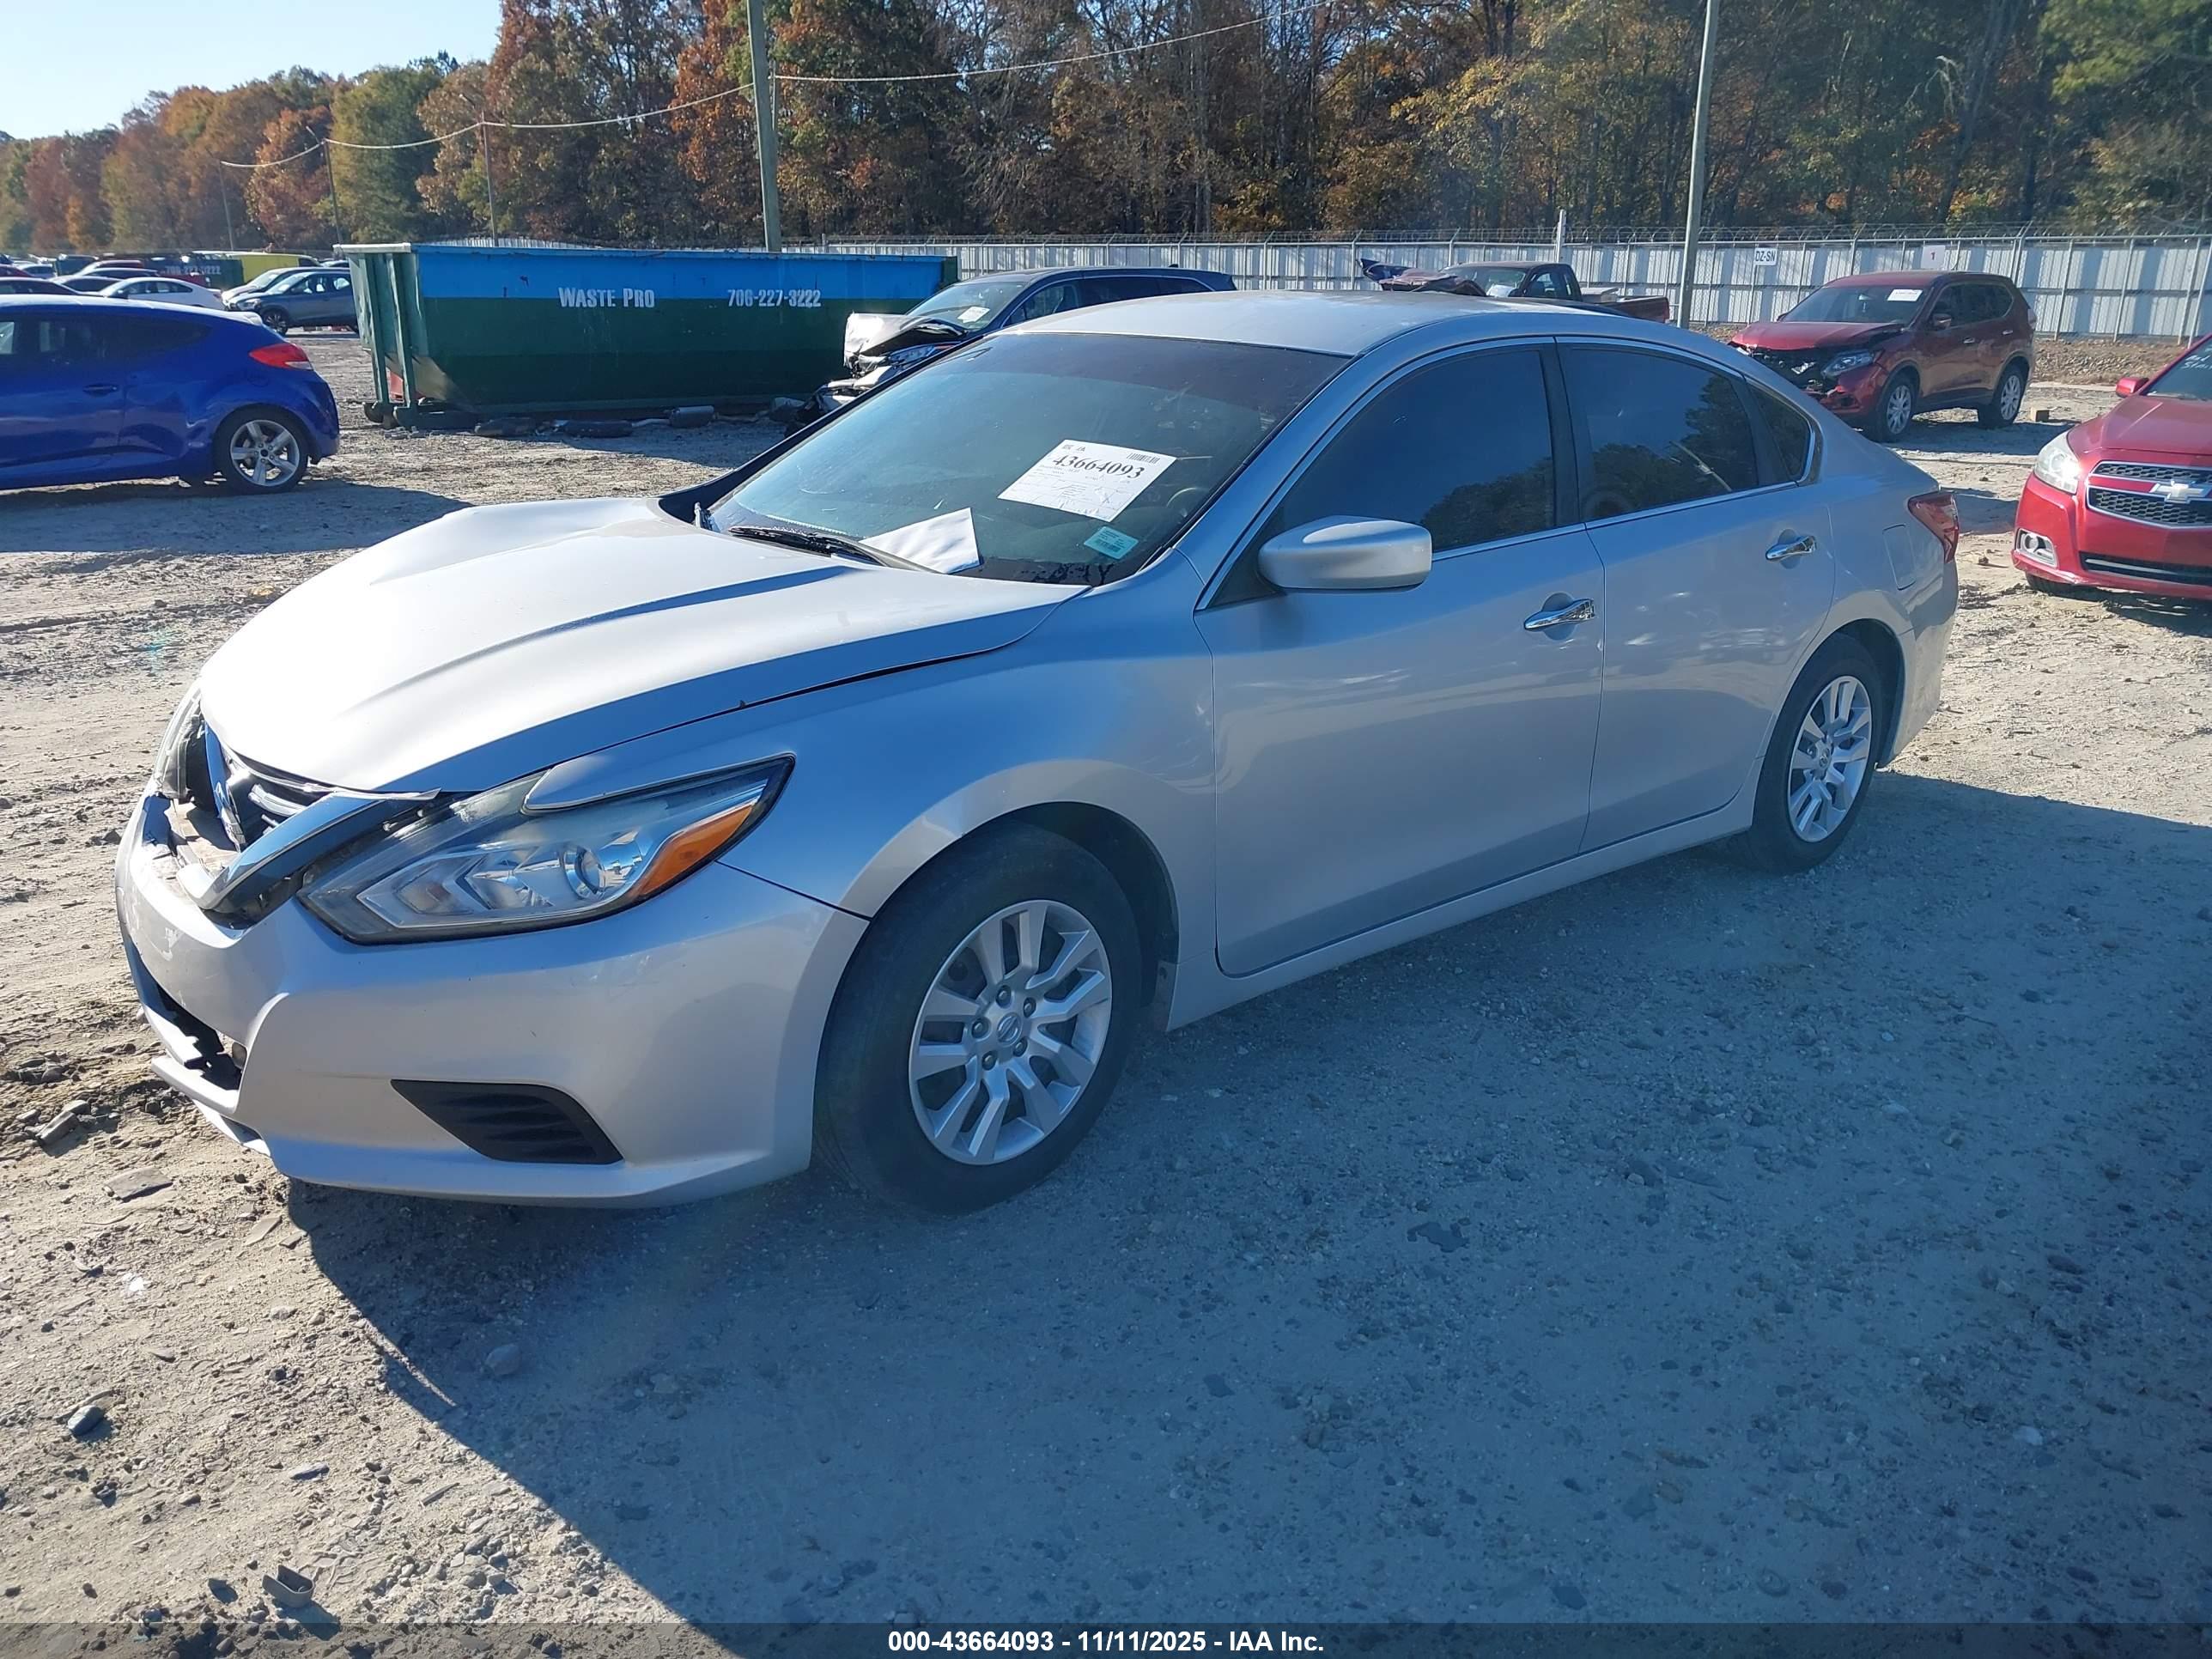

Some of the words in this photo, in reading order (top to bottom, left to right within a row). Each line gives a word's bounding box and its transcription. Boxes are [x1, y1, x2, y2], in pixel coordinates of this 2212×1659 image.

[1755, 250, 1776, 262] DZ-SN
[623, 288, 655, 308] PRO
[727, 289, 822, 308] 706-227-3222
[1053, 454, 1146, 479] 43664093
